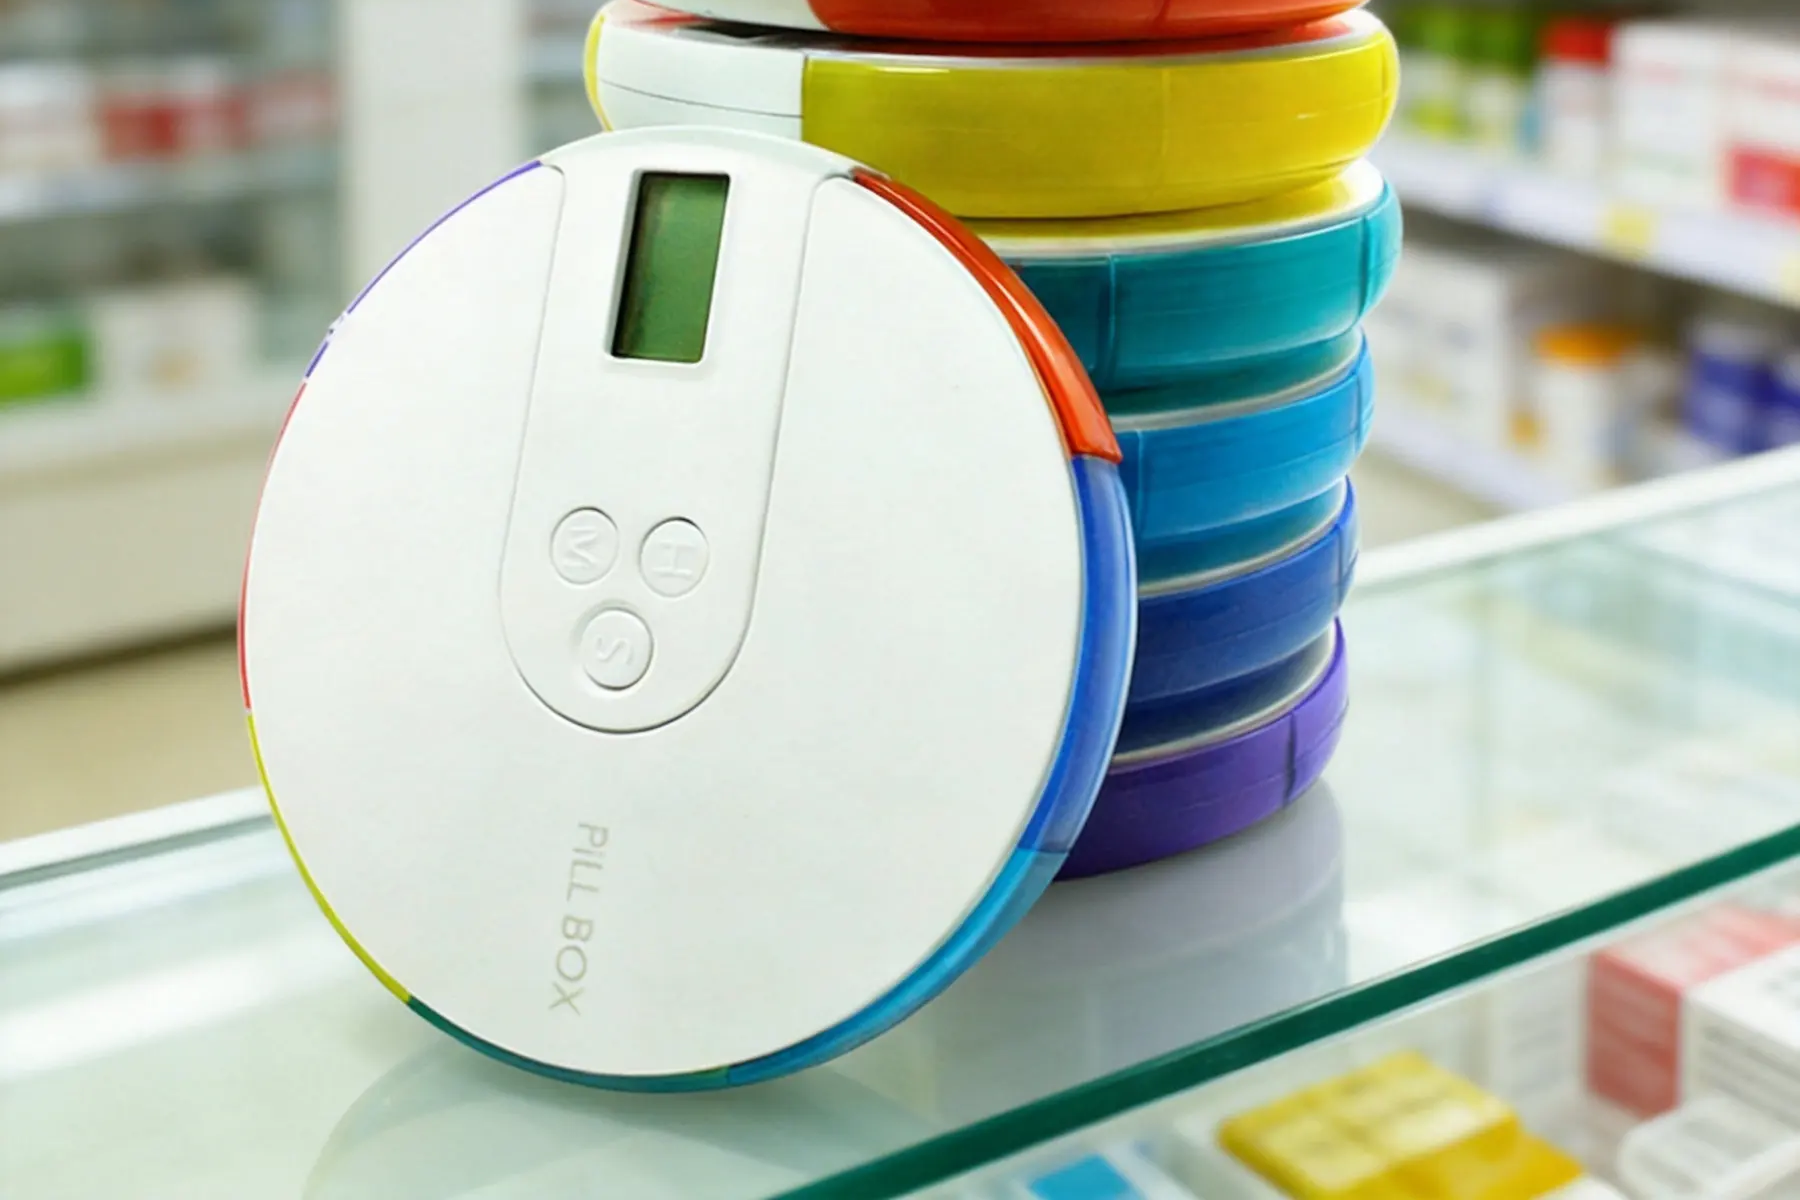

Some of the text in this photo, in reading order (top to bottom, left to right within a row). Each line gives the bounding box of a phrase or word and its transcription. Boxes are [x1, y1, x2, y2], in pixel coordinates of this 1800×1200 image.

[563, 524, 598, 569] M
[652, 539, 695, 580] H
[549, 914, 594, 1016] BOX
